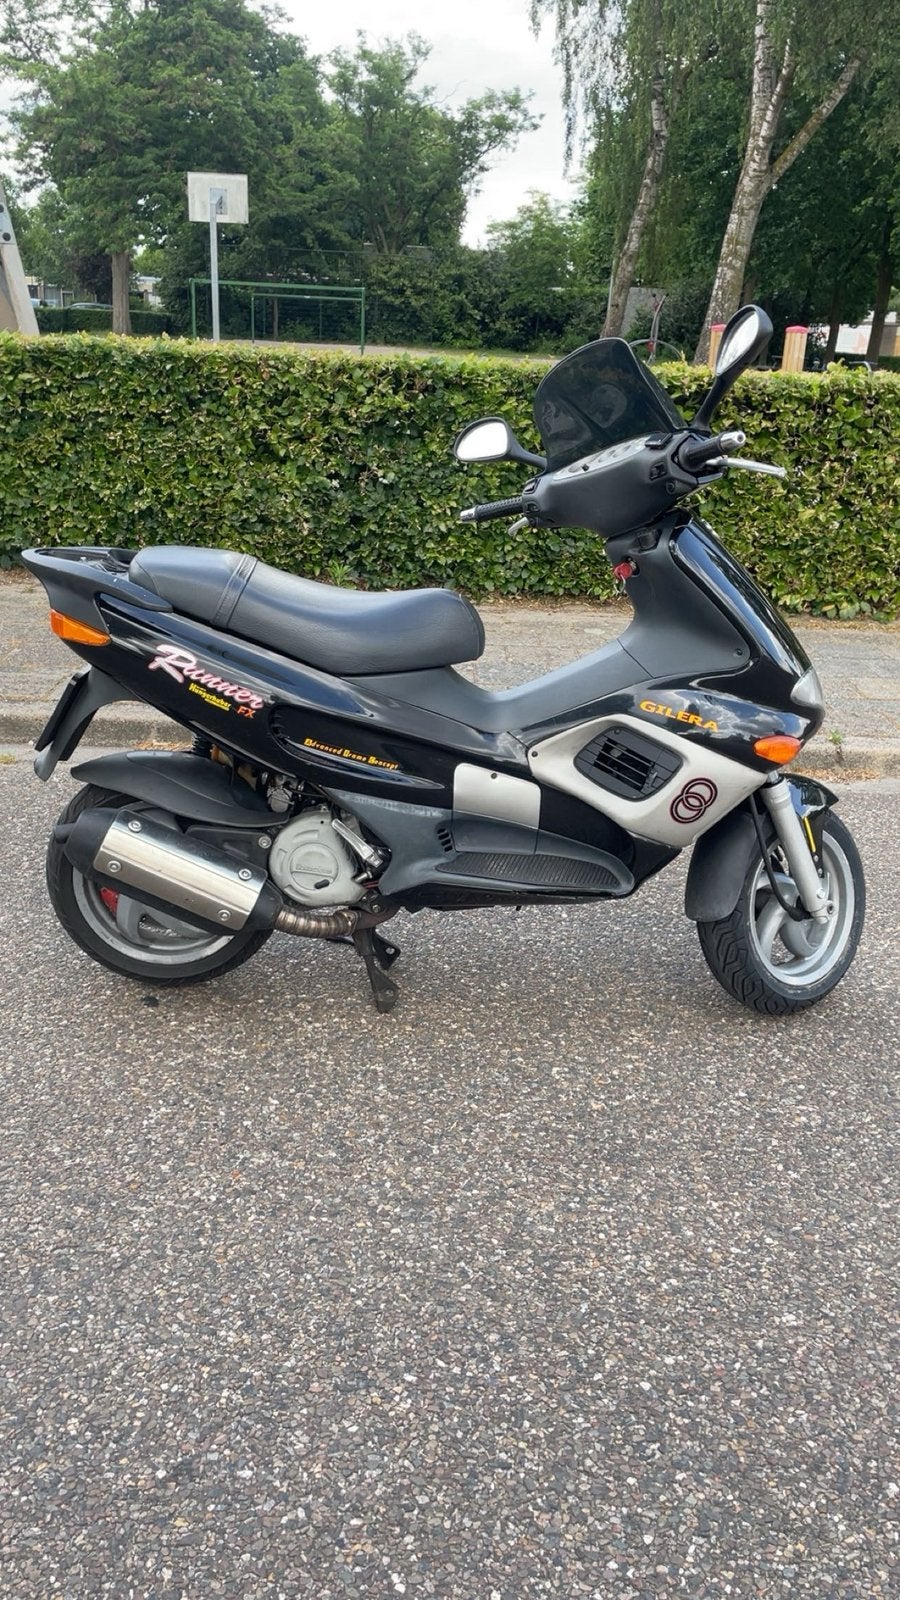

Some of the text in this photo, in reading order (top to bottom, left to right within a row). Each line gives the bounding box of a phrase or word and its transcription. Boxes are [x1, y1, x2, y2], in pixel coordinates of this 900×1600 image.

[148, 644, 264, 709] Runner
[237, 705, 256, 719] FX
[640, 700, 719, 733] GILERA
